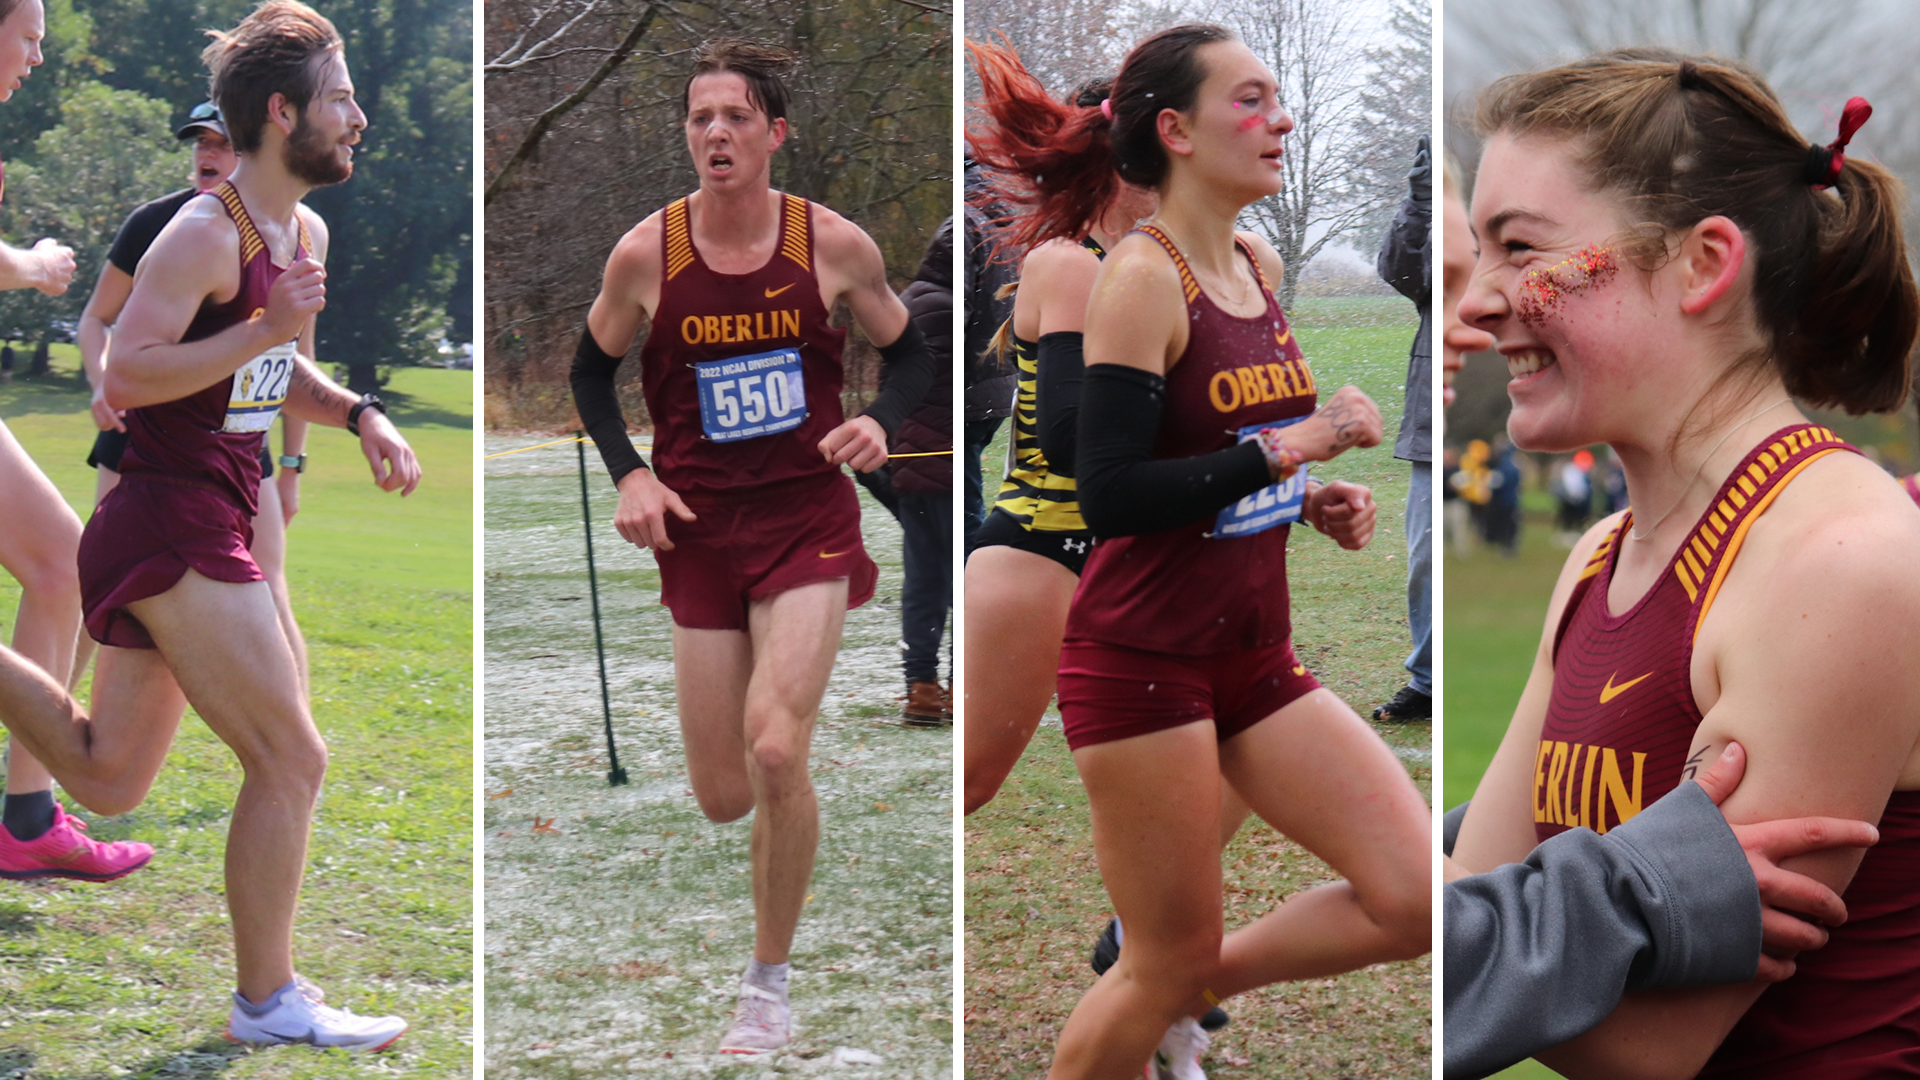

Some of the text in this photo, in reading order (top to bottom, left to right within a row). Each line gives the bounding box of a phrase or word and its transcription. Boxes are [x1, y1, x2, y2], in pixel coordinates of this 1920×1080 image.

[681, 309, 801, 344] OBERLIN
[700, 366, 722, 378] 2022
[722, 361, 748, 376] NCAA
[747, 354, 785, 371] DIVISION
[1209, 358, 1317, 413] OBERLI
[712, 370, 791, 427] 550
[1533, 740, 1648, 834] ERLIN
